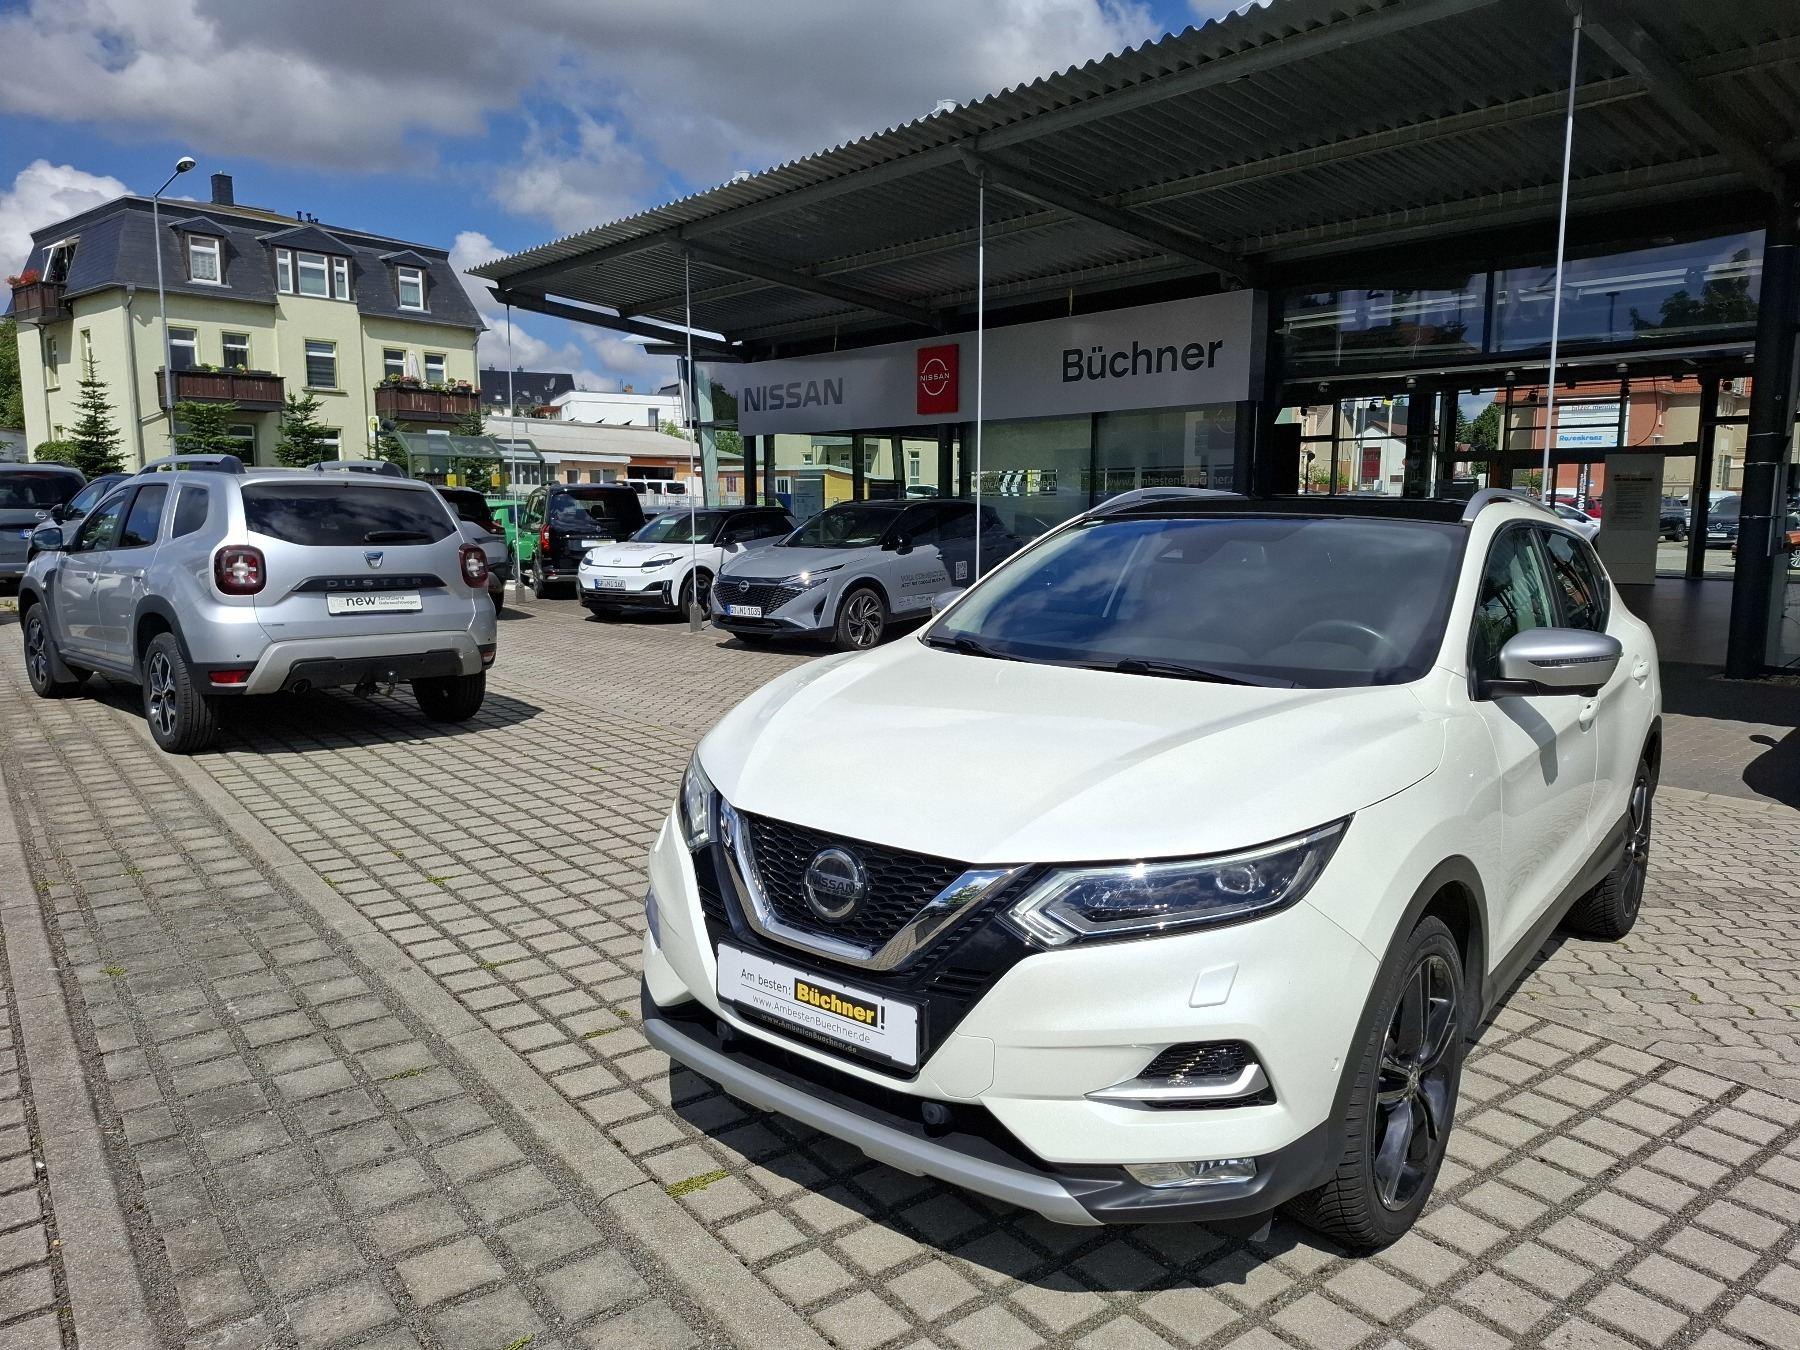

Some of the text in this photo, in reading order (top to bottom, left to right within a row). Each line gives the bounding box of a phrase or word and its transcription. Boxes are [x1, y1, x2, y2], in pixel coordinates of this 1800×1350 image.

[1062, 339, 1224, 383] Büchner
[920, 372, 950, 381] NISSAN
[744, 377, 843, 412] NISSAN
[326, 578, 422, 587] DUSTER
[811, 869, 856, 894] NISSAN
[741, 969, 755, 982] Am
[758, 974, 791, 995] besten:
[752, 995, 871, 1044] www.AmbestenBuechner.de
[760, 1013, 857, 1053] www.AmbestenBuechner.de
